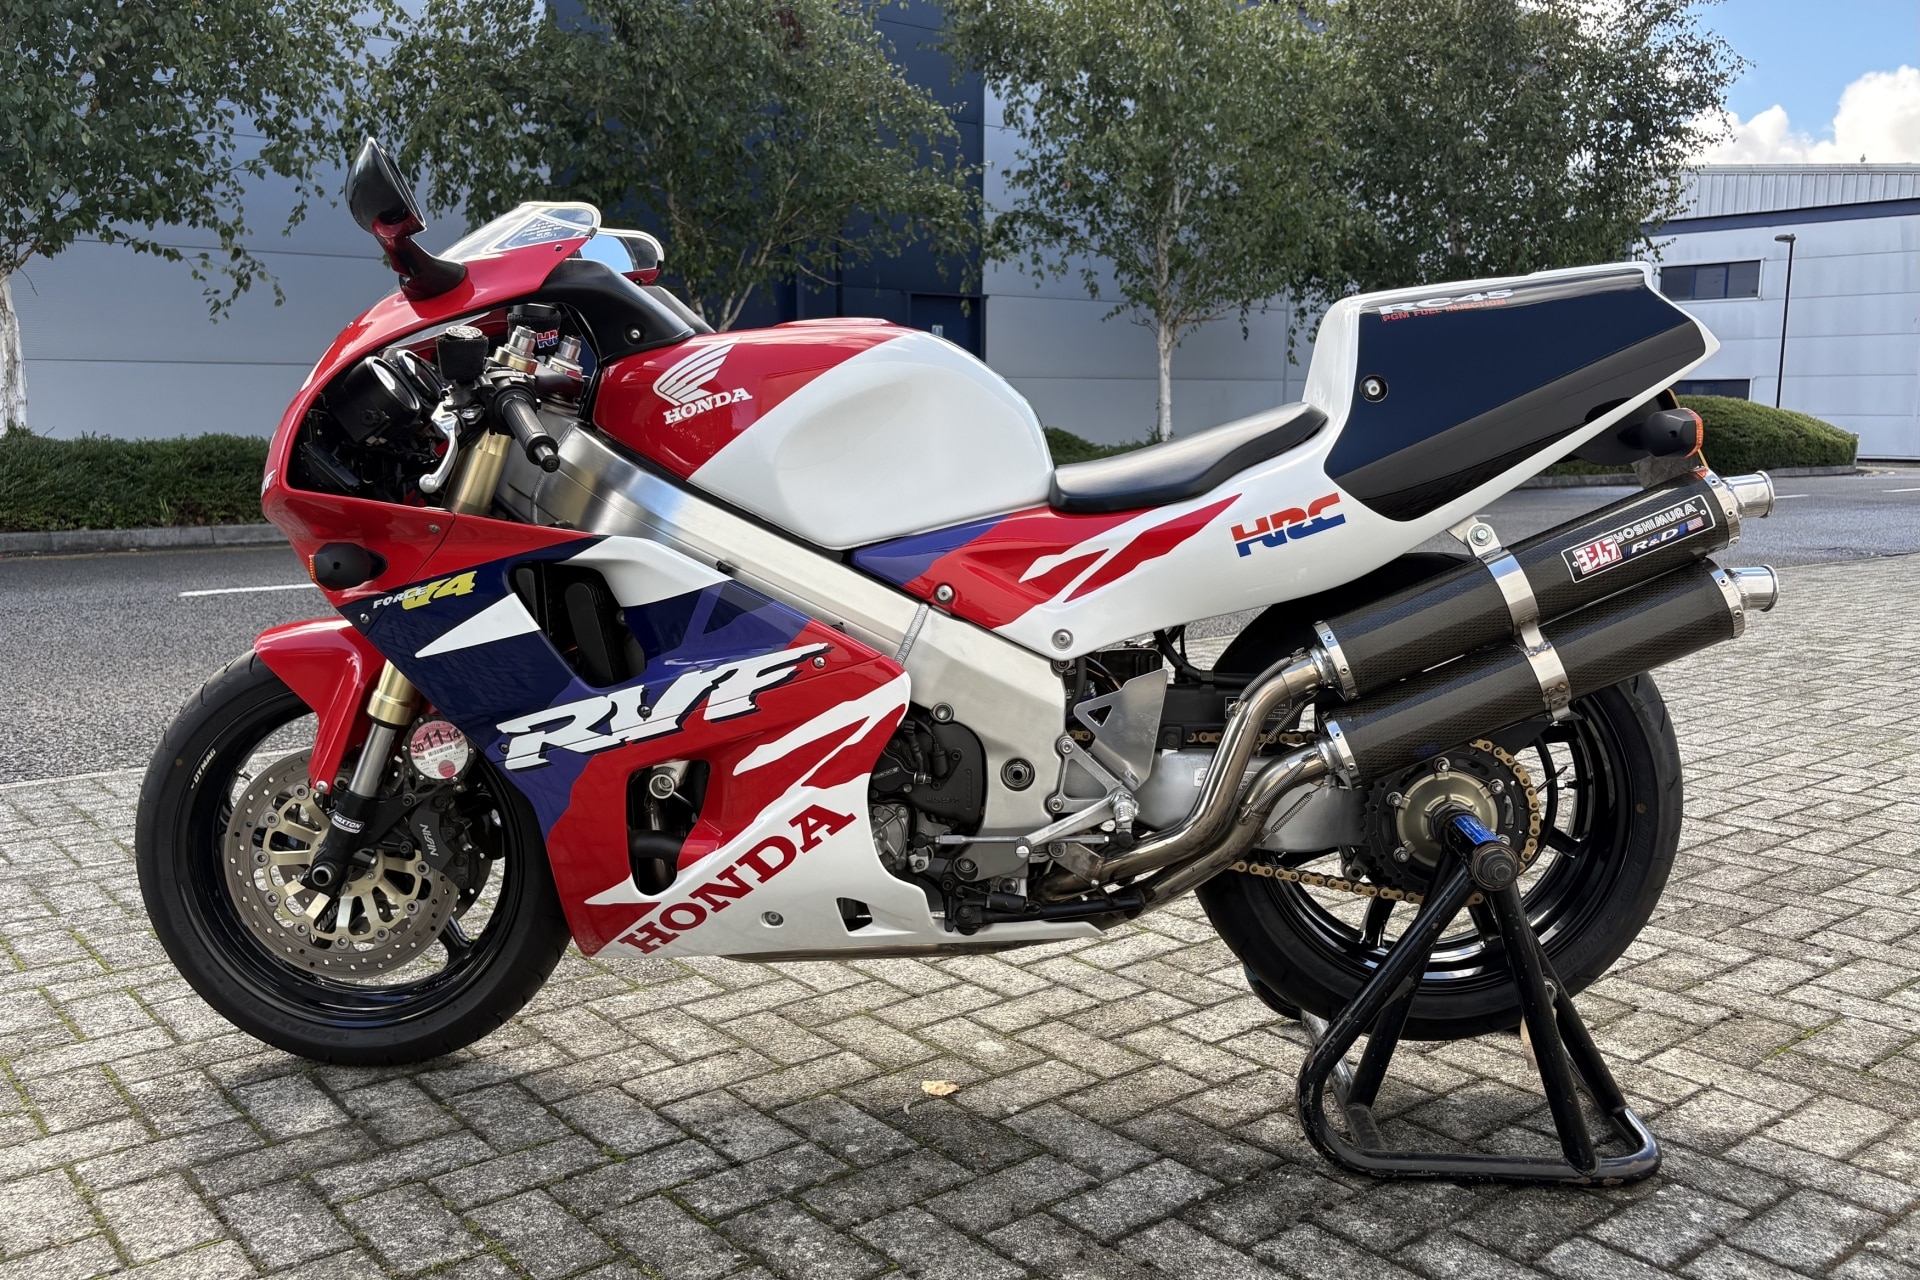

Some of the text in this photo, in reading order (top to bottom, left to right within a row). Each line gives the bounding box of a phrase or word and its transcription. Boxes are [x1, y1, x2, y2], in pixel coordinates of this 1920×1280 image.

[1378, 288, 1515, 315] RC45
[1382, 299, 1508, 322] PGM FUEL INJECTION
[537, 329, 560, 349] HR
[662, 387, 753, 425] HONDA
[1230, 491, 1347, 558] HRC
[1613, 503, 1698, 543] YOSHIMURA
[1631, 528, 1679, 554] R&D
[372, 586, 427, 609] FORCE
[402, 570, 478, 611] V4
[496, 642, 833, 771] RVF
[412, 742, 425, 754] 30
[423, 729, 444, 748] 11
[446, 728, 461, 742] 14
[419, 823, 439, 857] NISSIN
[617, 804, 857, 955] HONDA
